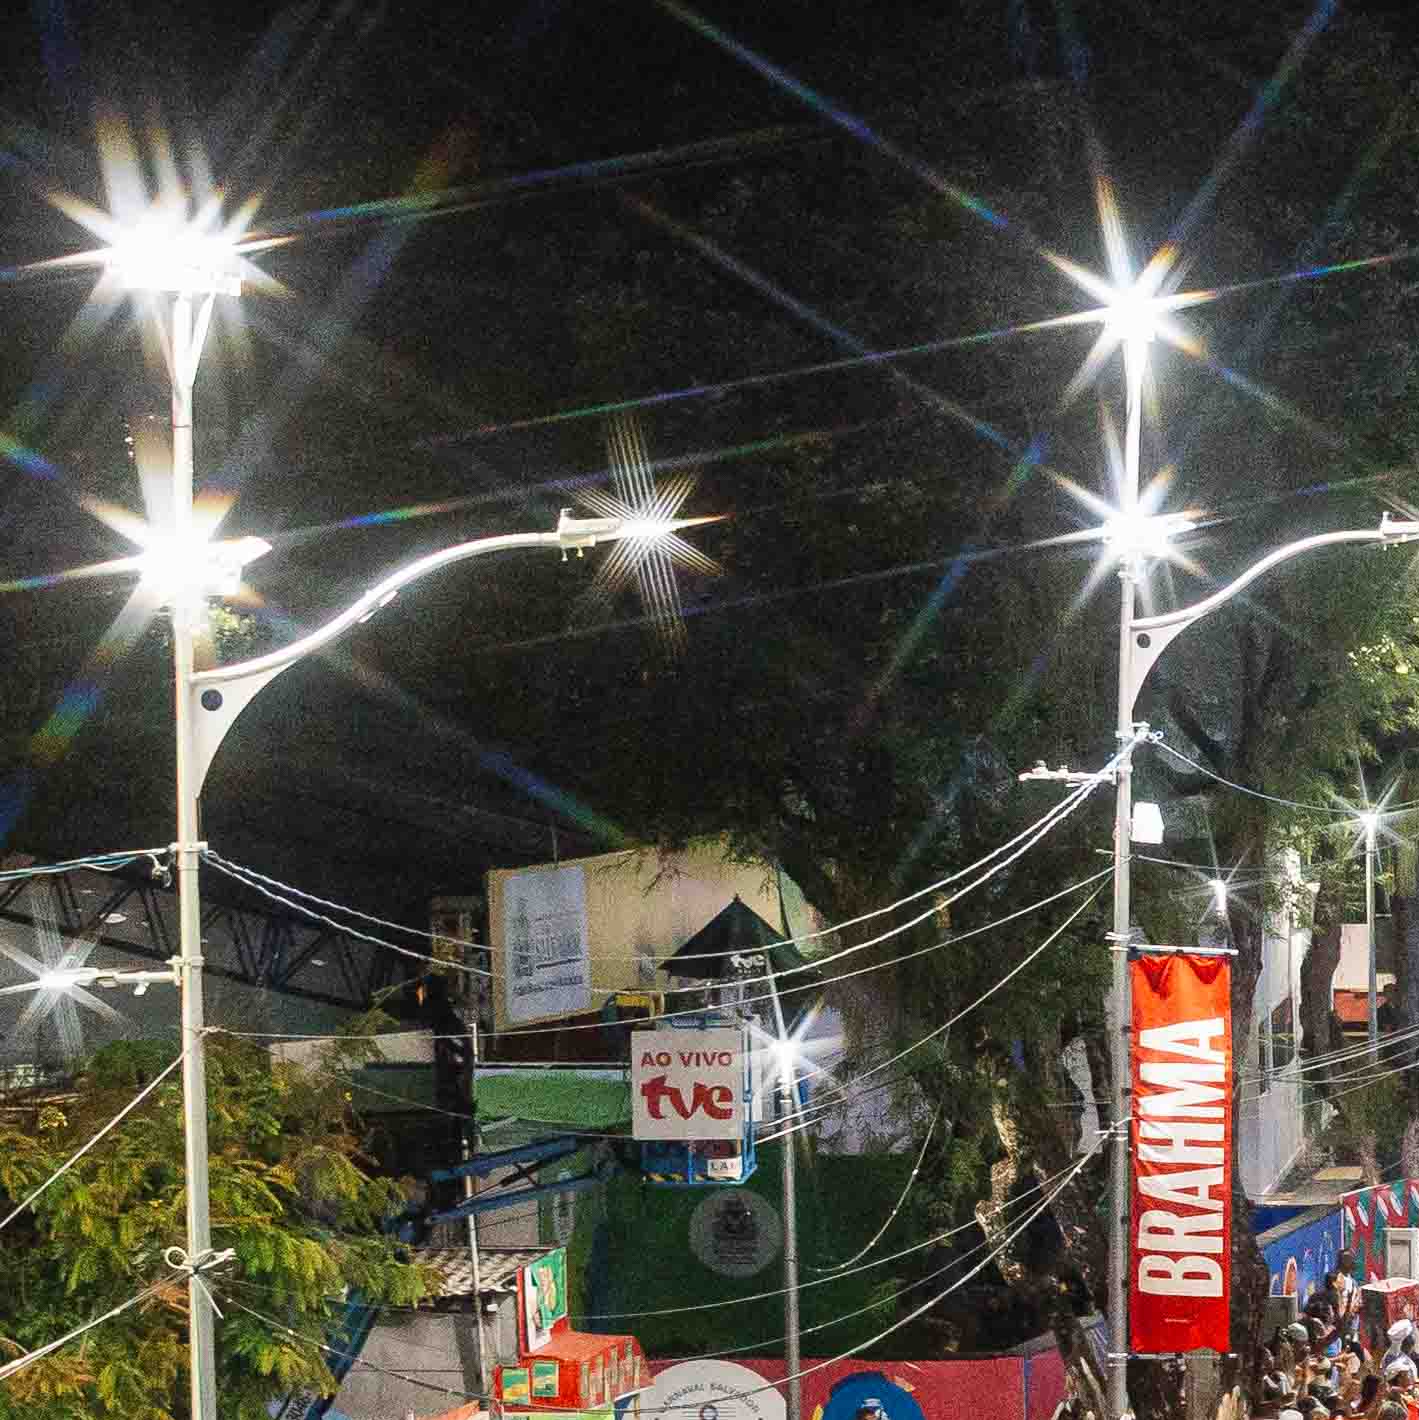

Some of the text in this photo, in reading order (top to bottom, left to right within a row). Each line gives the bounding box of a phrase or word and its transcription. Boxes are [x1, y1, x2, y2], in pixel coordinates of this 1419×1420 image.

[640, 1052, 733, 1067] AO VIVO
[640, 1075, 734, 1120] tve
[1137, 1016, 1225, 1298] BRAHMA
